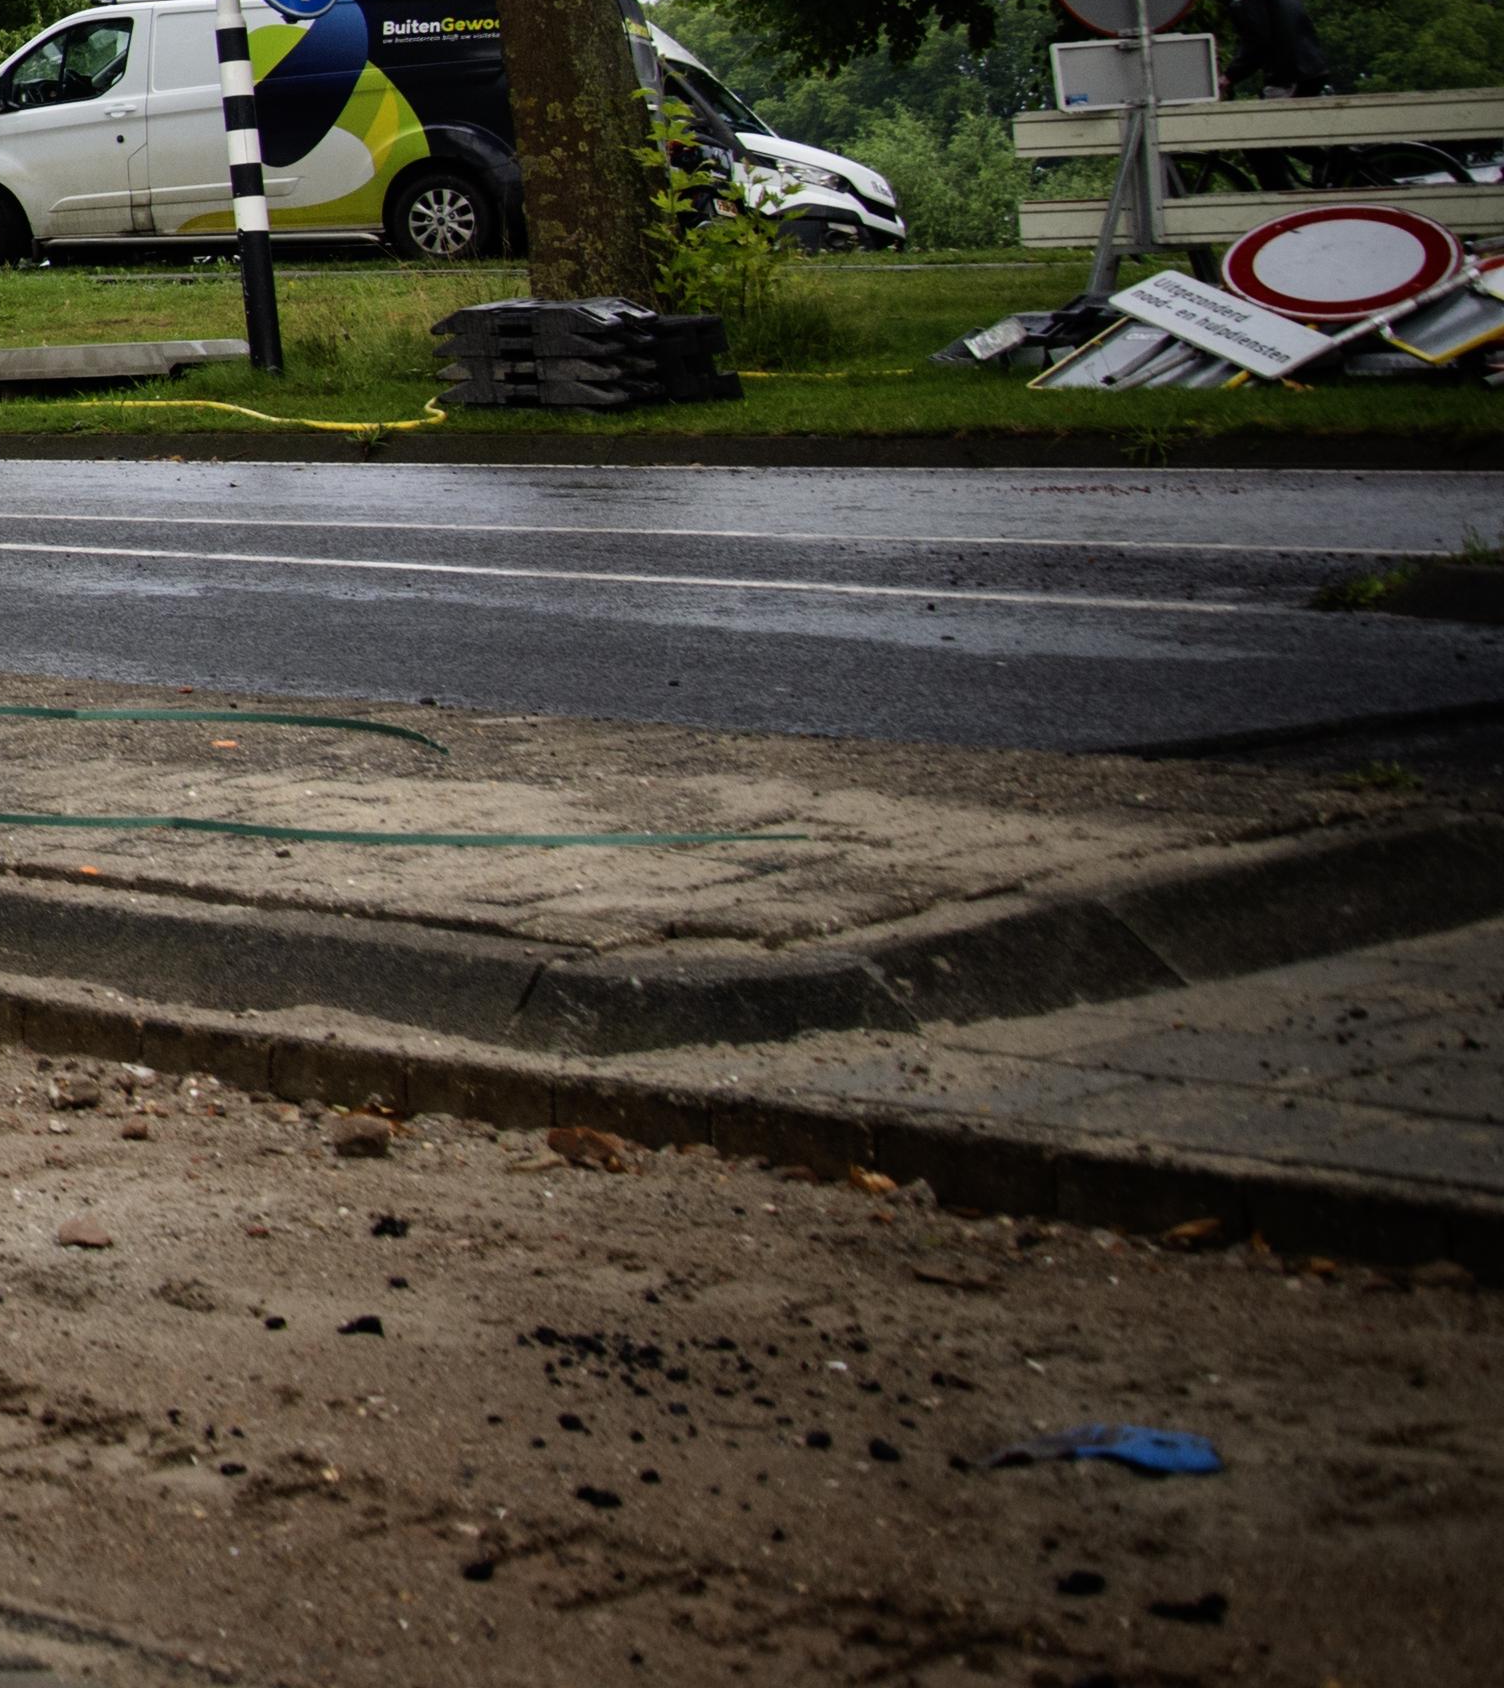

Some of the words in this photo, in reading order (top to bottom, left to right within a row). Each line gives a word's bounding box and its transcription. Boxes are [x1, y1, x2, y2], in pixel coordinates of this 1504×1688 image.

[383, 17, 500, 36] BuitenGewo
[1152, 277, 1252, 324] Uitgezonderd
[1130, 288, 1173, 310] nood-
[1174, 308, 1196, 322] en
[1194, 316, 1292, 364] hulpdiensten
